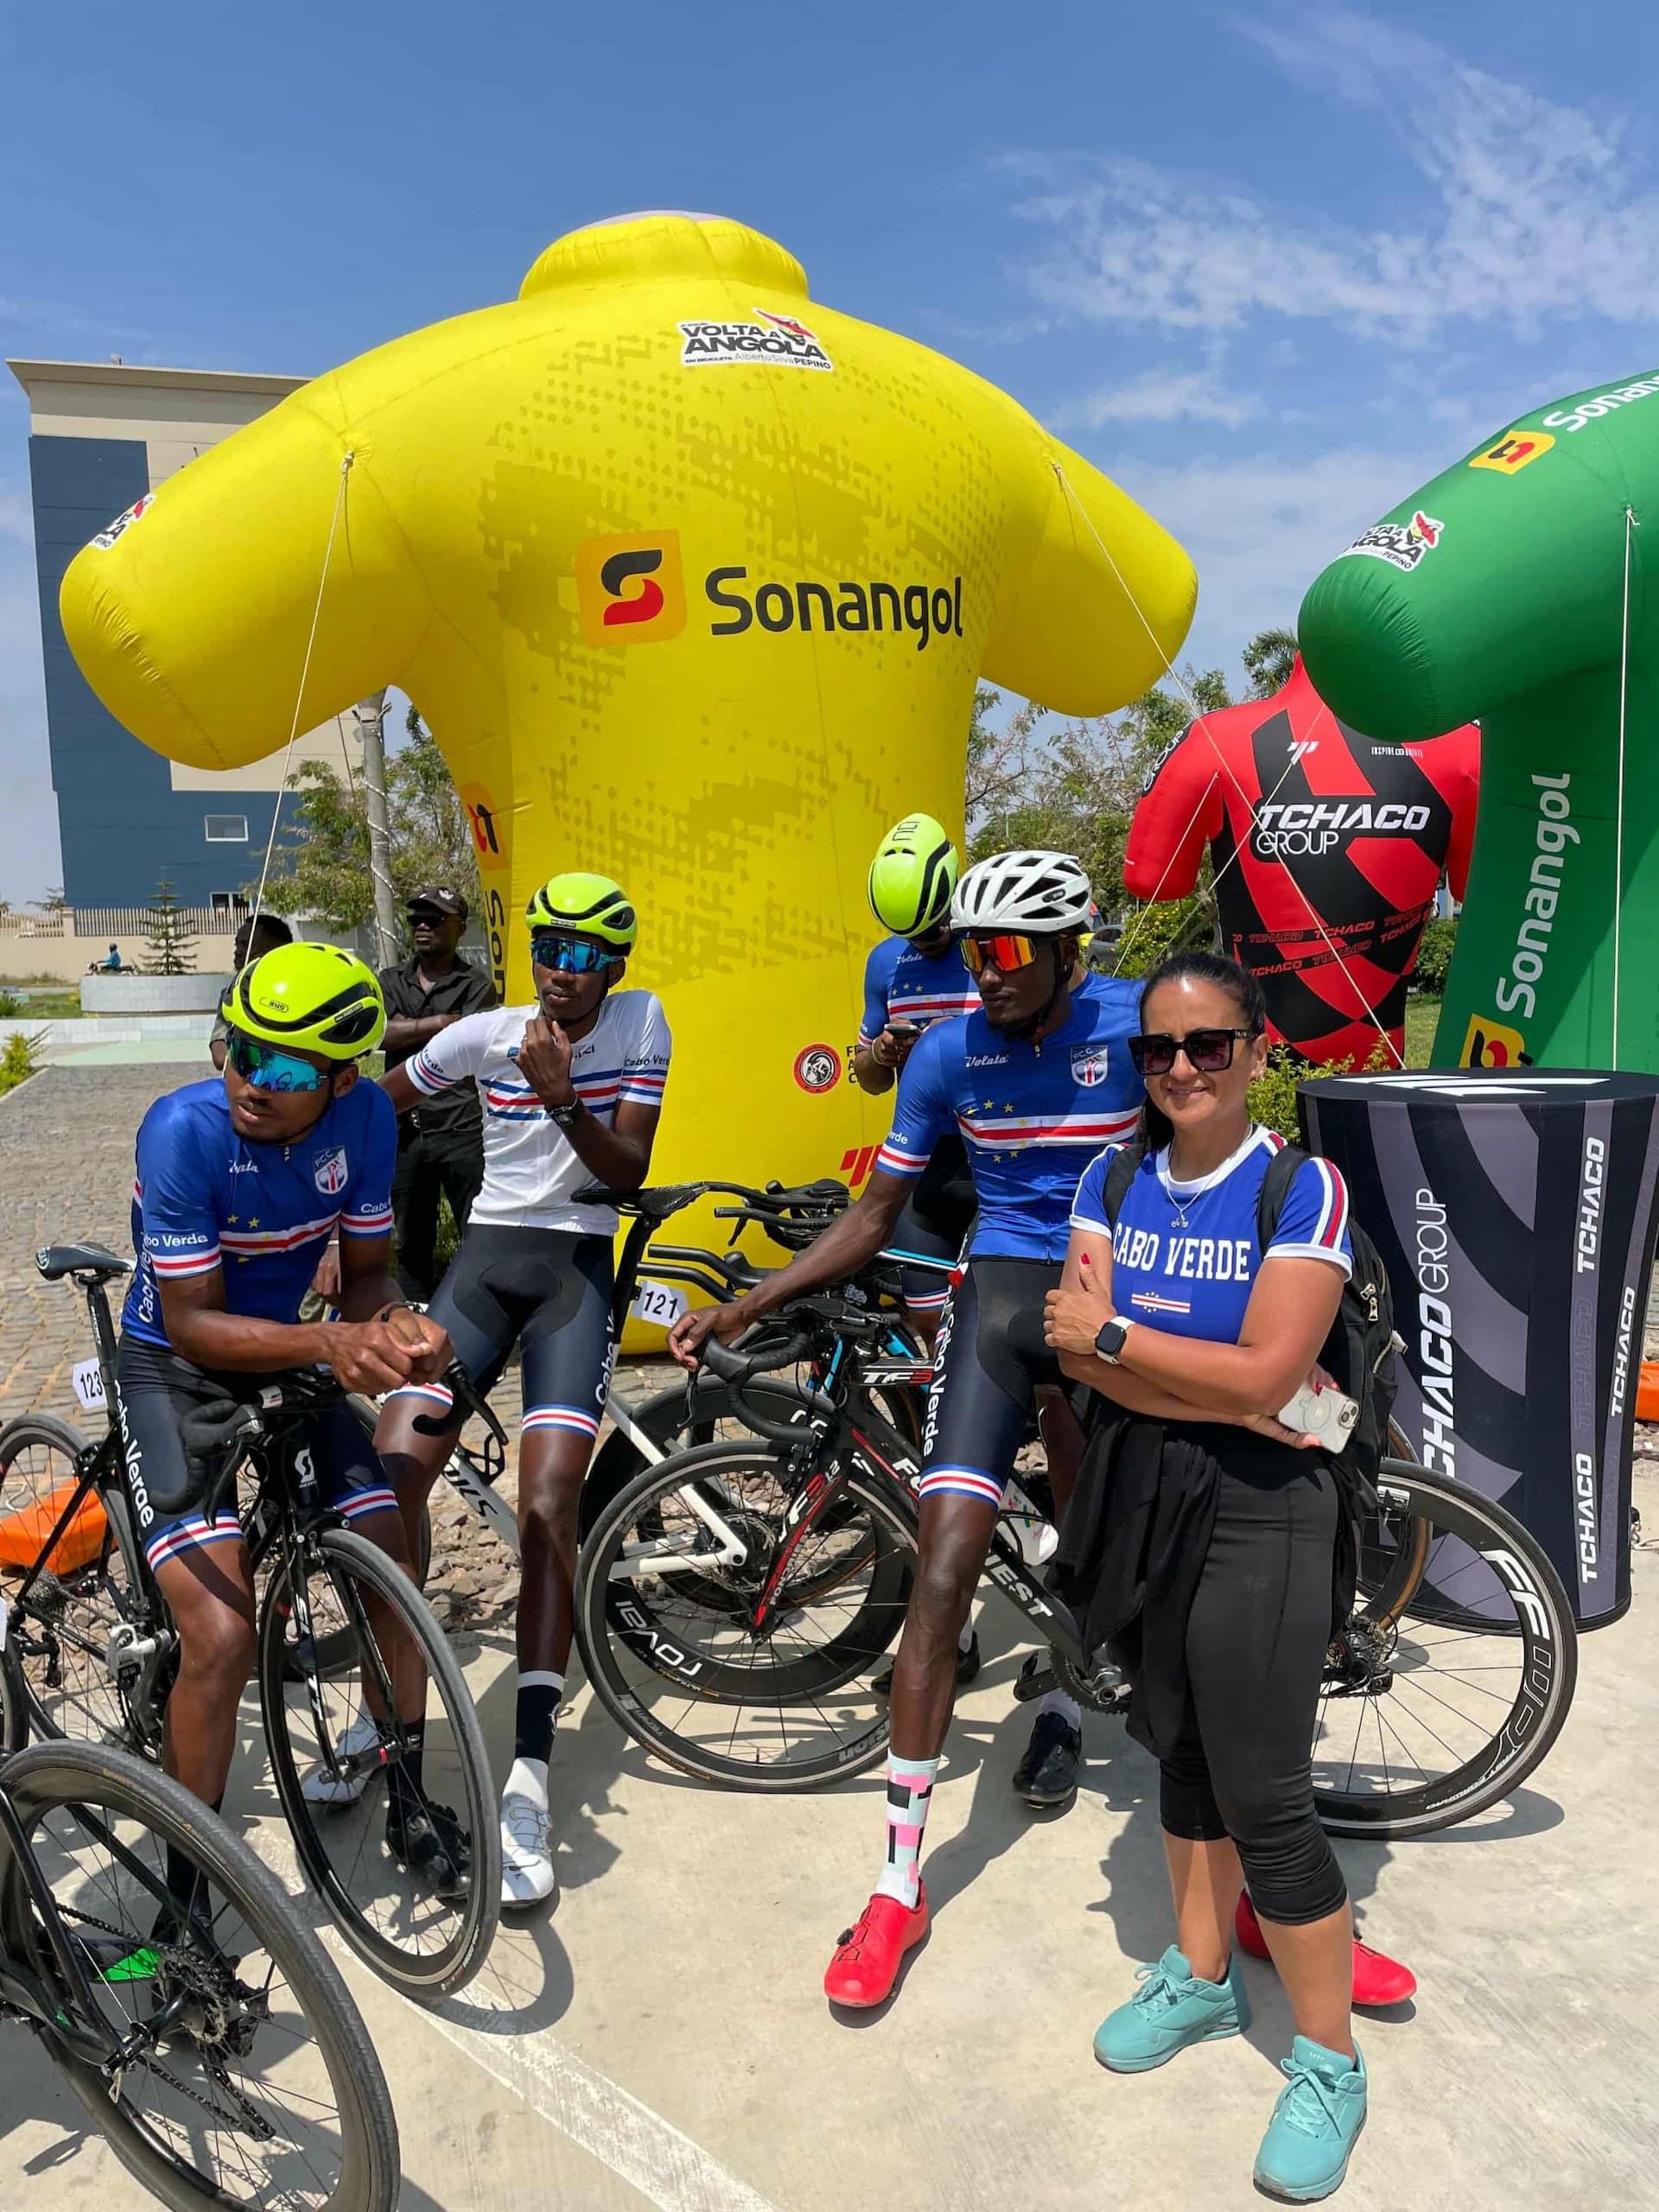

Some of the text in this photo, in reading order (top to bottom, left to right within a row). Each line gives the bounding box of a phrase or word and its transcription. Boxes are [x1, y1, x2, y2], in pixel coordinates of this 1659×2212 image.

[681, 325, 766, 337] VOLTA
[684, 336, 827, 360] ANGOLA
[795, 357, 831, 369] PEPINO
[1542, 375, 1659, 433] Sonan
[1382, 551, 1412, 569] PEPINO
[705, 565, 963, 652] Sonangol
[1259, 804, 1431, 830] TCHACO
[1256, 830, 1339, 855] GROUP
[1496, 772, 1581, 1019] Sonangol
[1314, 920, 1376, 939] TCHACO
[1249, 960, 1302, 977] TCHACO
[1380, 913, 1421, 944] TCHACO
[624, 1055, 651, 1067] Cabo
[964, 1053, 1008, 1068] Volata
[1577, 1136, 1605, 1273] TCHACO
[162, 1233, 208, 1248] Verde
[1113, 1223, 1251, 1281] CABO VERDE
[644, 1290, 678, 1319] 121
[1415, 1187, 1455, 1478] CHACO GROUP
[1611, 1286, 1637, 1417] TCHACO
[80, 1370, 103, 1399] 123
[595, 1341, 614, 1406] Cabo
[923, 1374, 947, 1458] Verde
[1576, 1451, 1598, 1584] TCHACO
